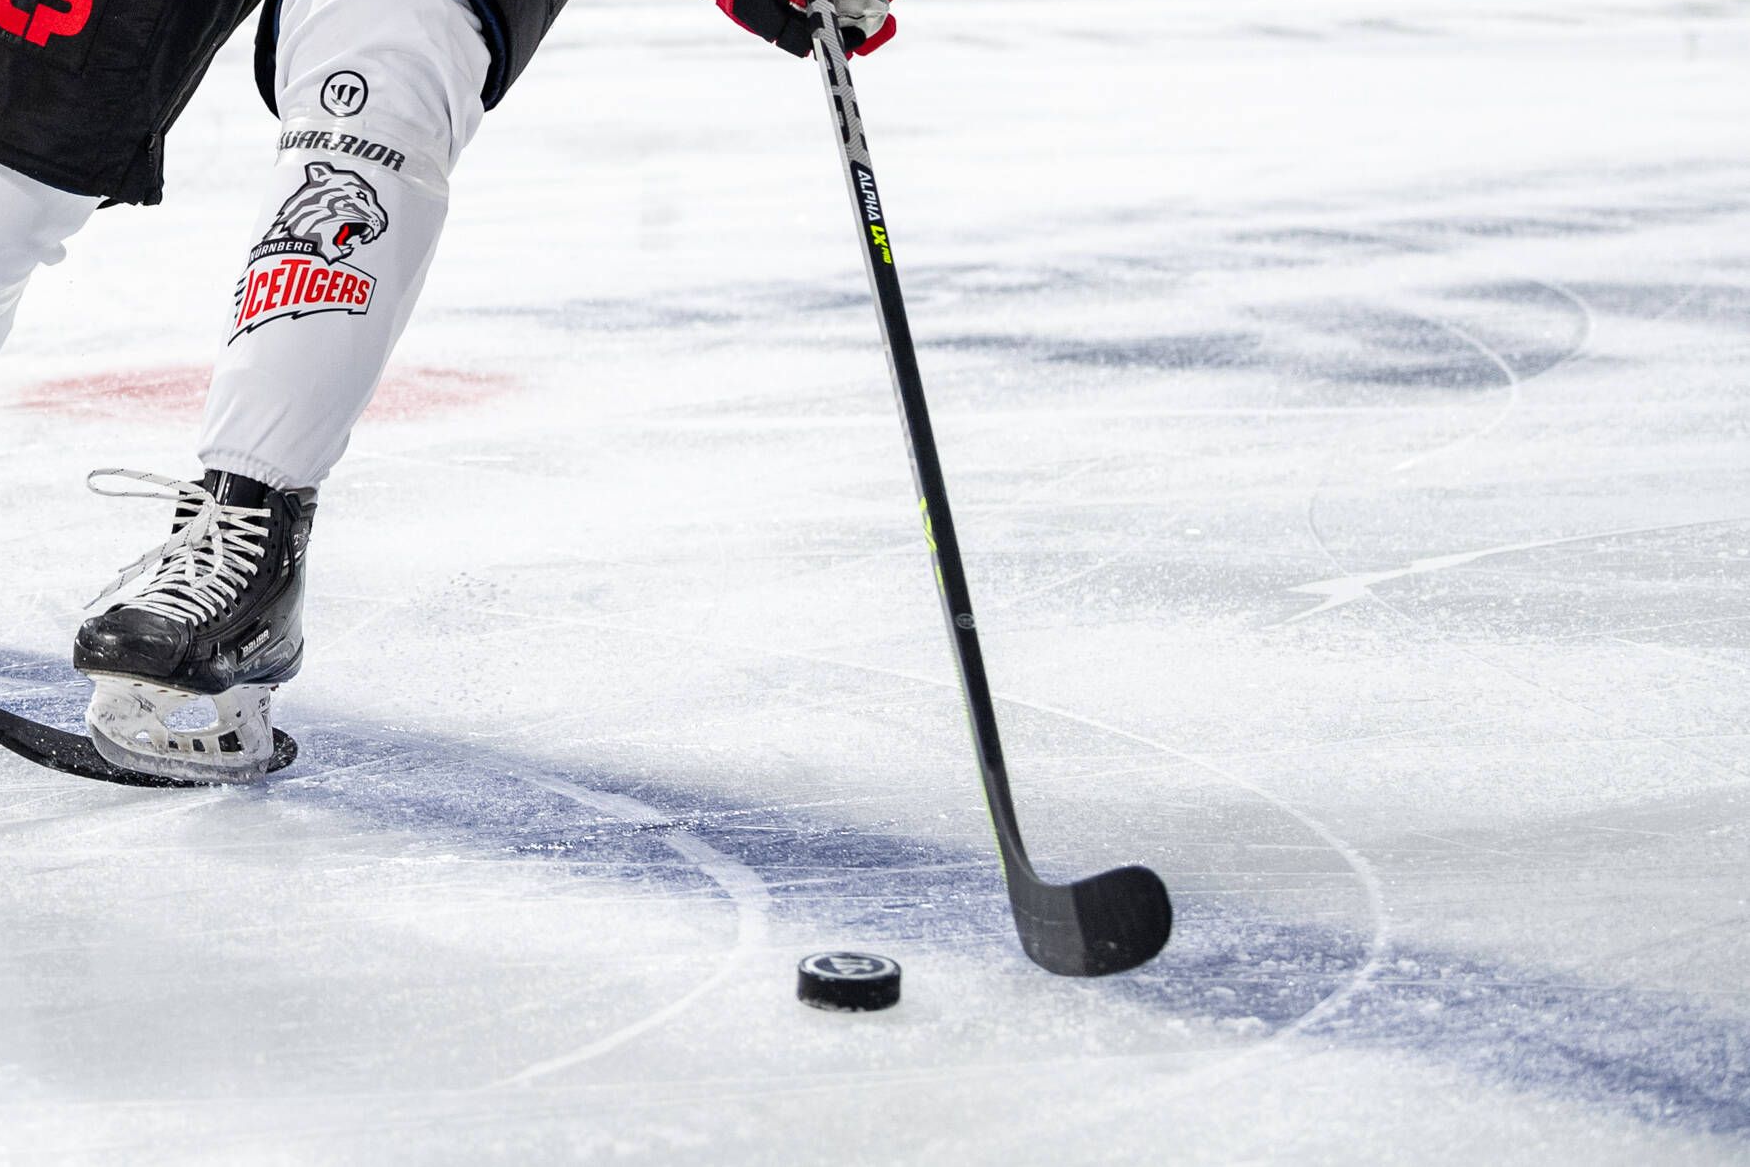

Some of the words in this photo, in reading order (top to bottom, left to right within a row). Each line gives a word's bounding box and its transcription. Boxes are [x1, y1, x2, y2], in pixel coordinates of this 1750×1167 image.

[857, 168, 881, 221] ALPHA
[870, 225, 887, 247] LX
[251, 241, 313, 262] NÜRNBERG
[236, 259, 370, 328] ICETIGERS
